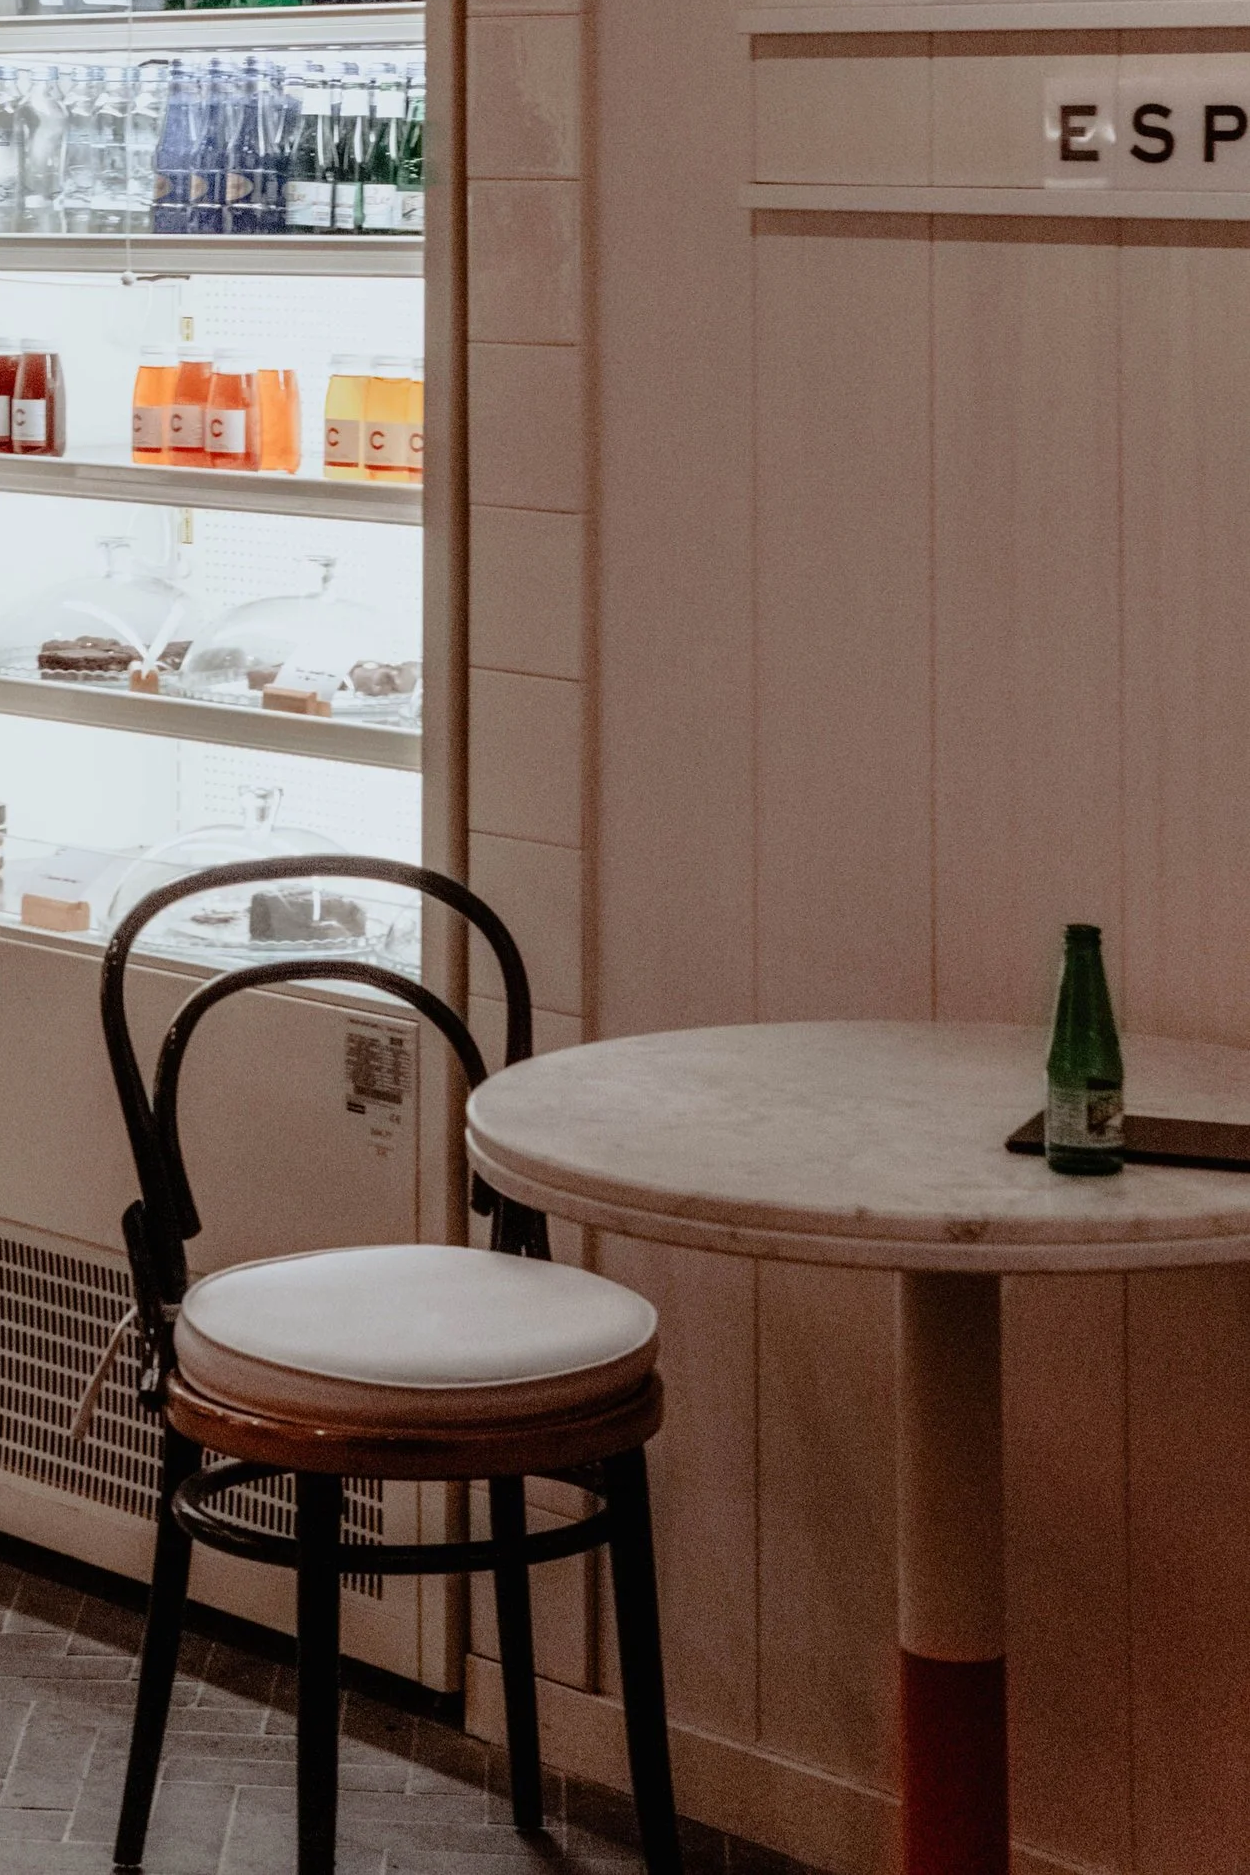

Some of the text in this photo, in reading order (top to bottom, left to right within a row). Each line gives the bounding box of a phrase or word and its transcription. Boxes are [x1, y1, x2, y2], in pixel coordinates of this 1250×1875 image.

[1060, 103, 1249, 164] ESP
[211, 418, 223, 438] C
[326, 427, 340, 447] C
[370, 430, 385, 451] C
